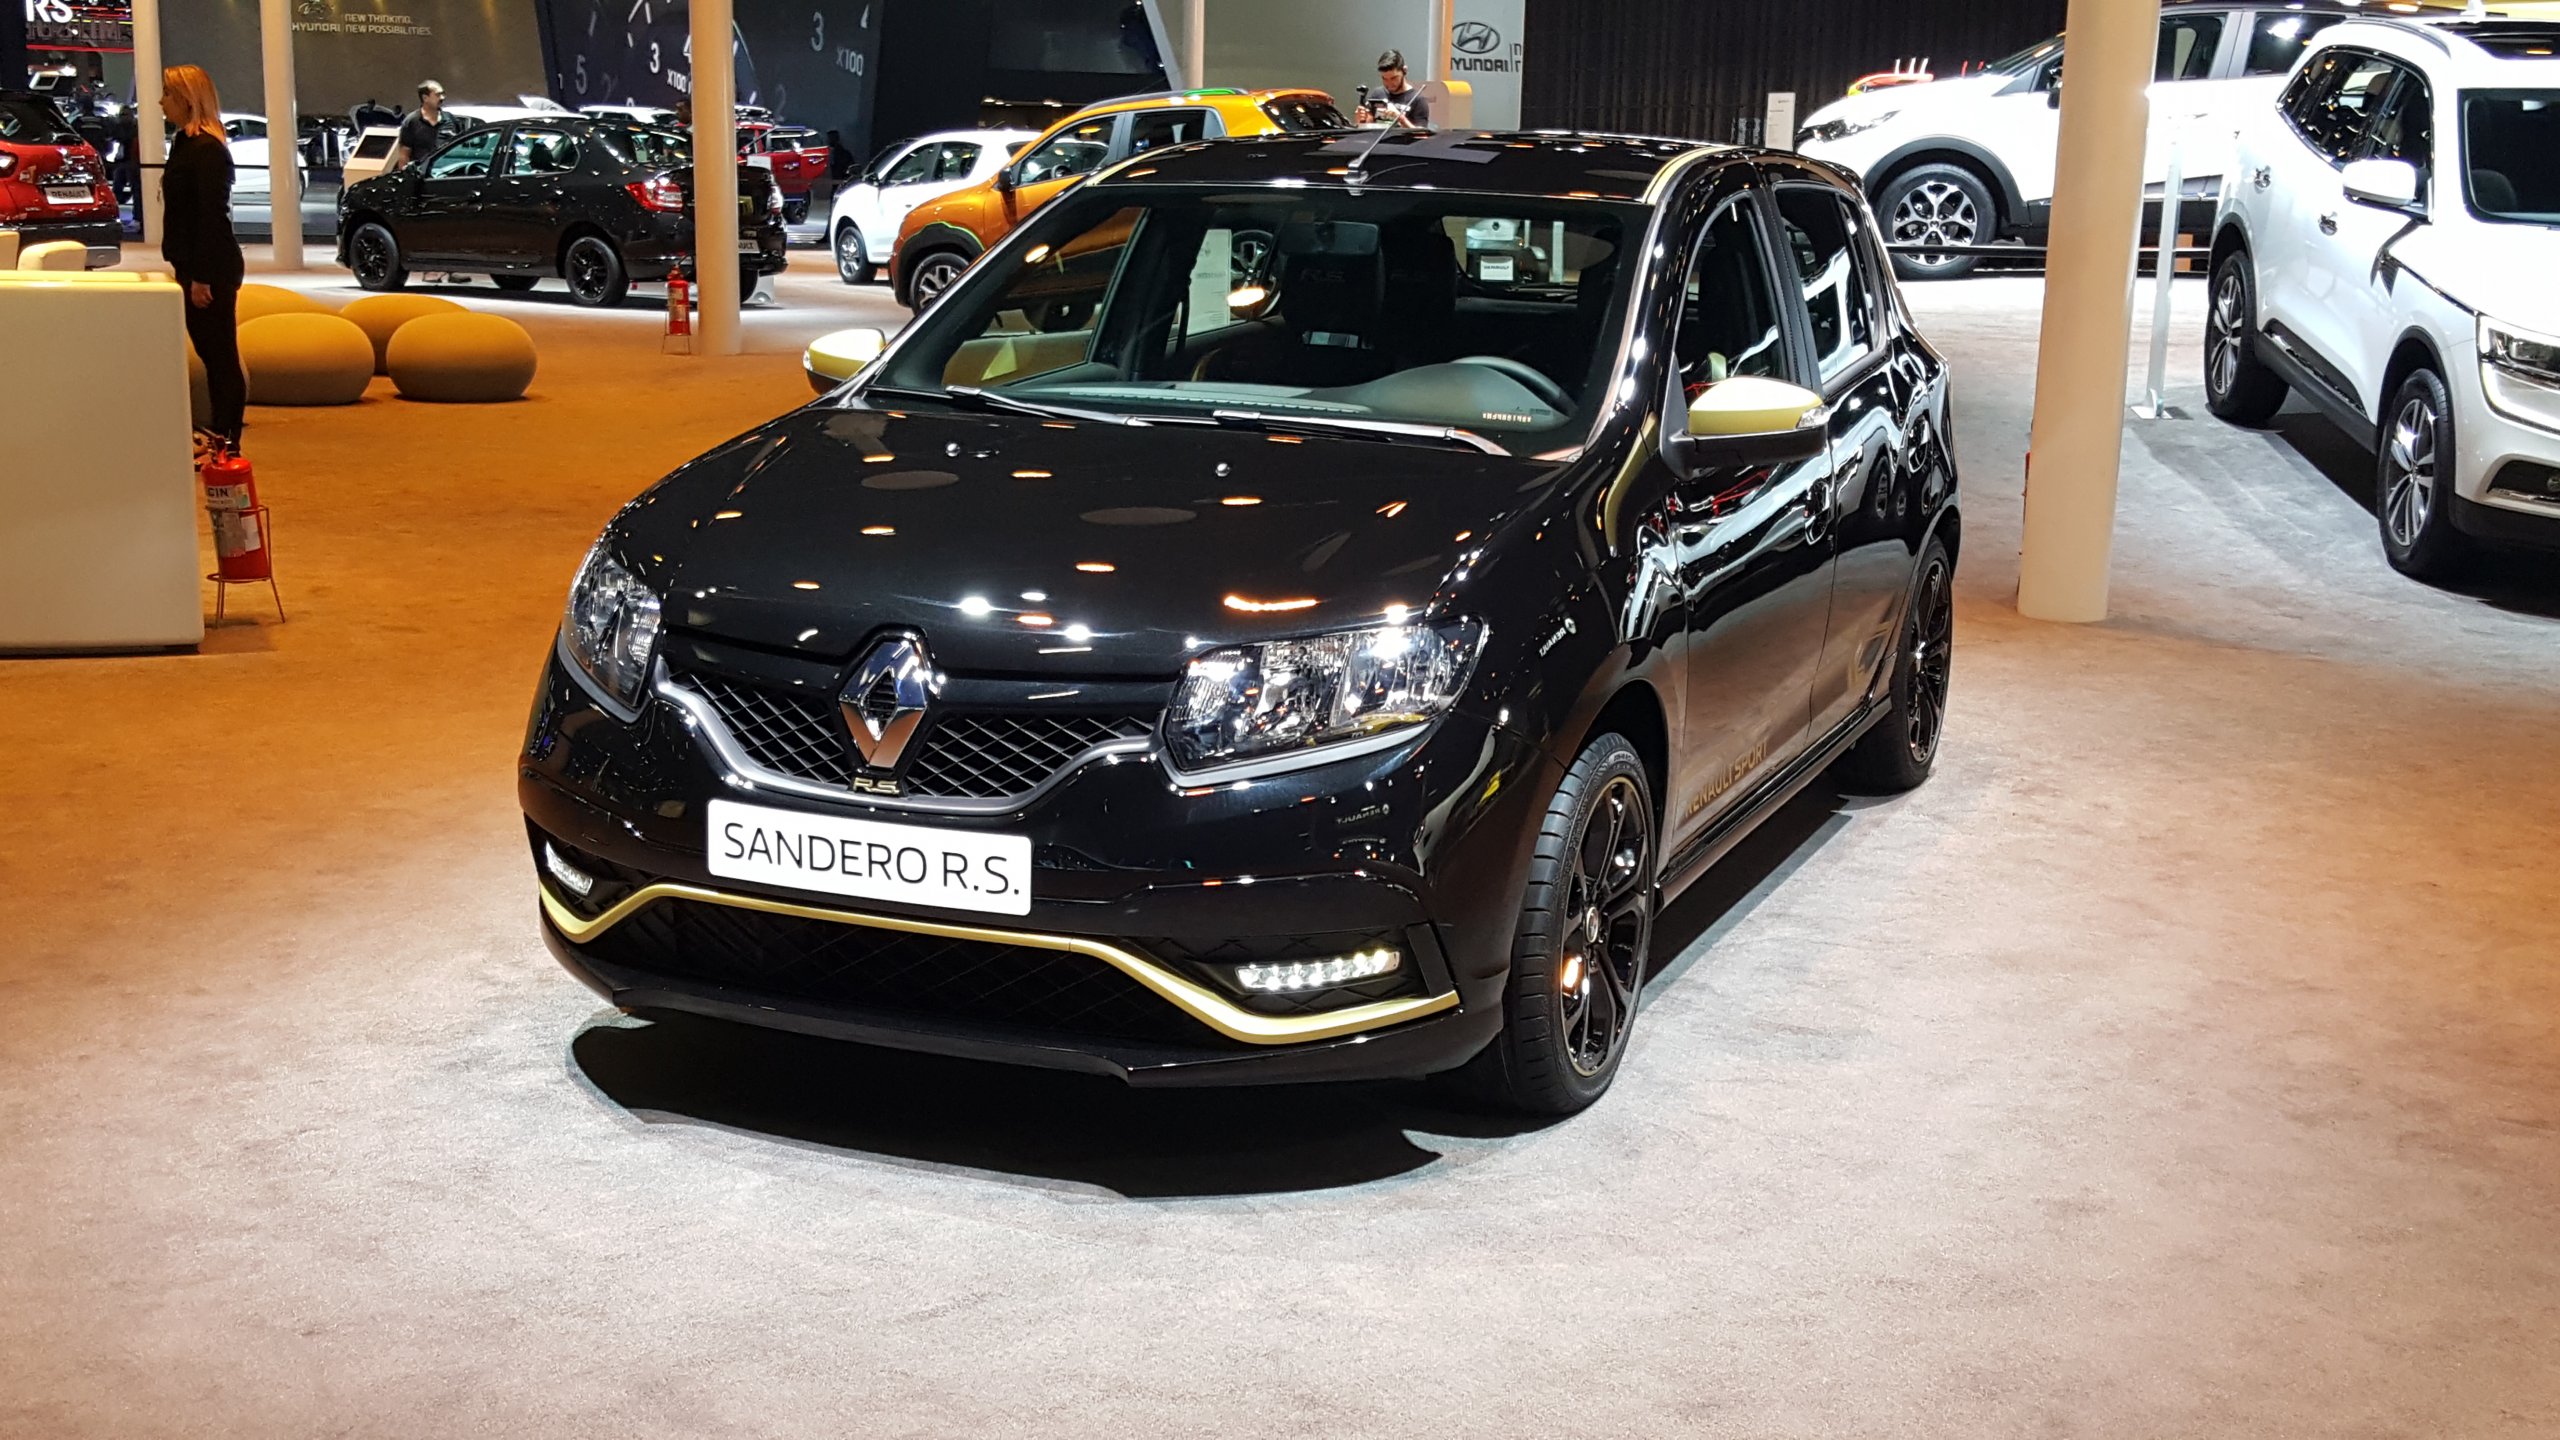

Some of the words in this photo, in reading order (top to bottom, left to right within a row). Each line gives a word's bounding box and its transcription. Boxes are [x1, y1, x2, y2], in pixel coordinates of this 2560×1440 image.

[292, 22, 341, 32] HYUNDAI
[344, 13, 366, 23] NEW
[345, 24, 367, 33] NEW
[811, 11, 824, 51] 3
[575, 54, 587, 95] 5
[649, 42, 660, 74] 3
[1734, 737, 1768, 781] SPORT
[723, 822, 928, 885] SANDERO
[941, 851, 1020, 896] R.S.
